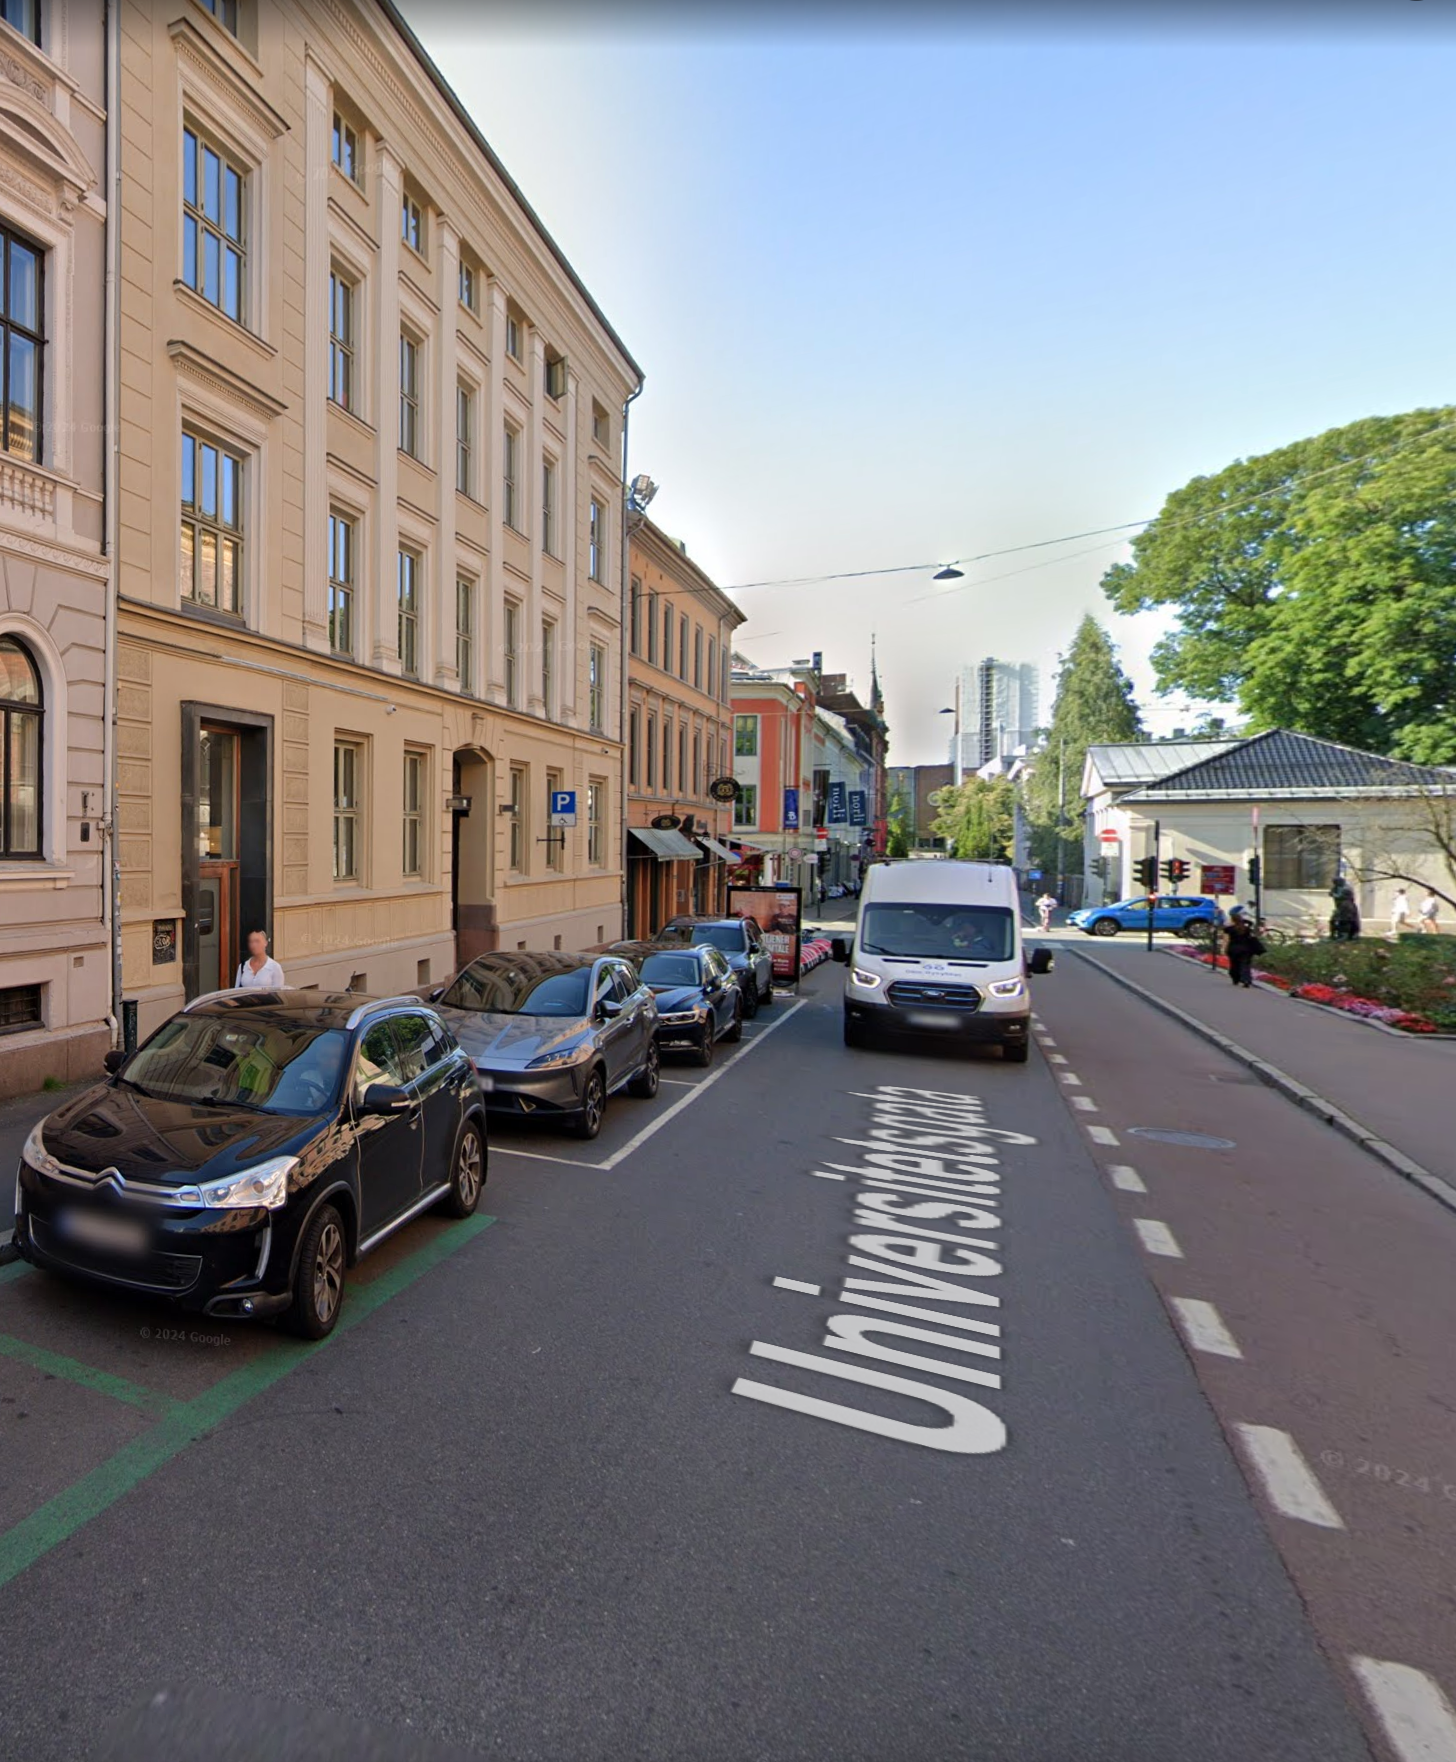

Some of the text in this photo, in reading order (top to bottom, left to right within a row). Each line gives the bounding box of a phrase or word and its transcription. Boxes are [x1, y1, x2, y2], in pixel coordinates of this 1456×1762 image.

[556, 793, 570, 811] P
[832, 787, 845, 818] norli
[852, 795, 865, 822] norli
